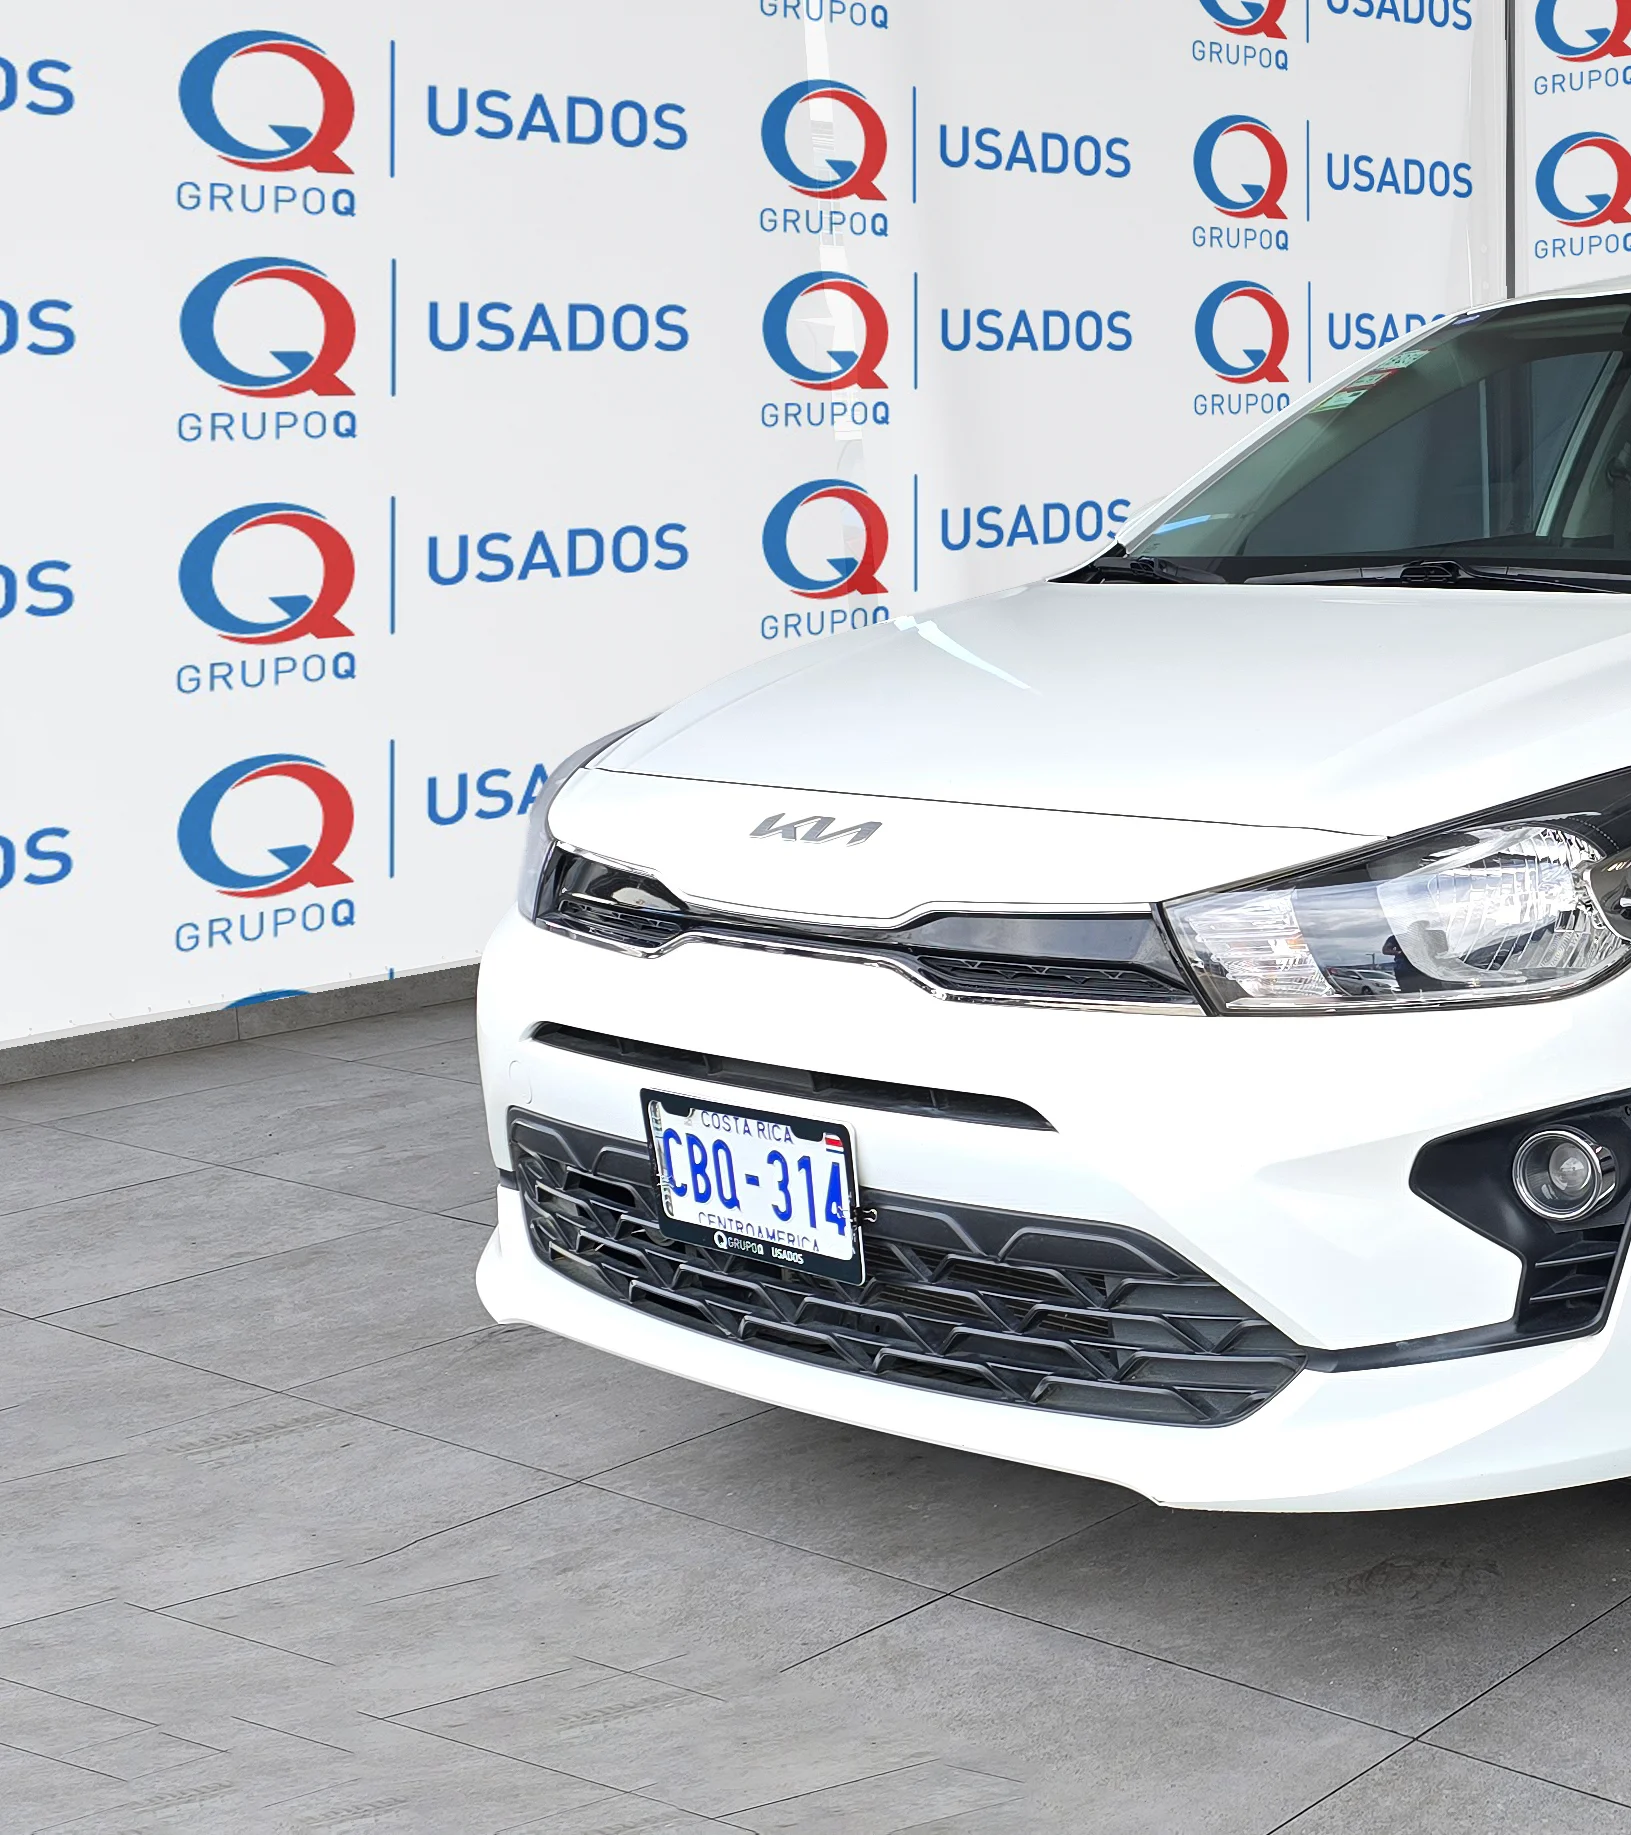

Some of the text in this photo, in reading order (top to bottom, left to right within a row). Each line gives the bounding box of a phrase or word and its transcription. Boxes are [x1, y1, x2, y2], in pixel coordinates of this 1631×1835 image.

[759, 0, 888, 29] GRUPOQ
[1192, 40, 1288, 71] GRUPOQ
[428, 84, 688, 151] USADOS
[939, 124, 1131, 178] USADOS
[1326, 152, 1472, 198] USADOS
[176, 182, 356, 217] GRUPOQ
[759, 208, 888, 237] GRUPOQ
[1192, 226, 1289, 251] GRUPOQ
[428, 301, 690, 352] USADOS
[940, 308, 1133, 352] USADOS
[177, 410, 357, 443] GRUPOQ
[761, 401, 890, 428] GRUPOQ
[940, 498, 1131, 551] USADOS
[427, 522, 689, 586] USADOS
[177, 651, 356, 694] GRUPOQ
[426, 763, 549, 826] USA
[176, 897, 355, 952] GRUPOQ
[701, 1110, 794, 1144] COSTA RICA
[663, 1127, 846, 1236] CBQ-314
[771, 1246, 805, 1265] USADOS
